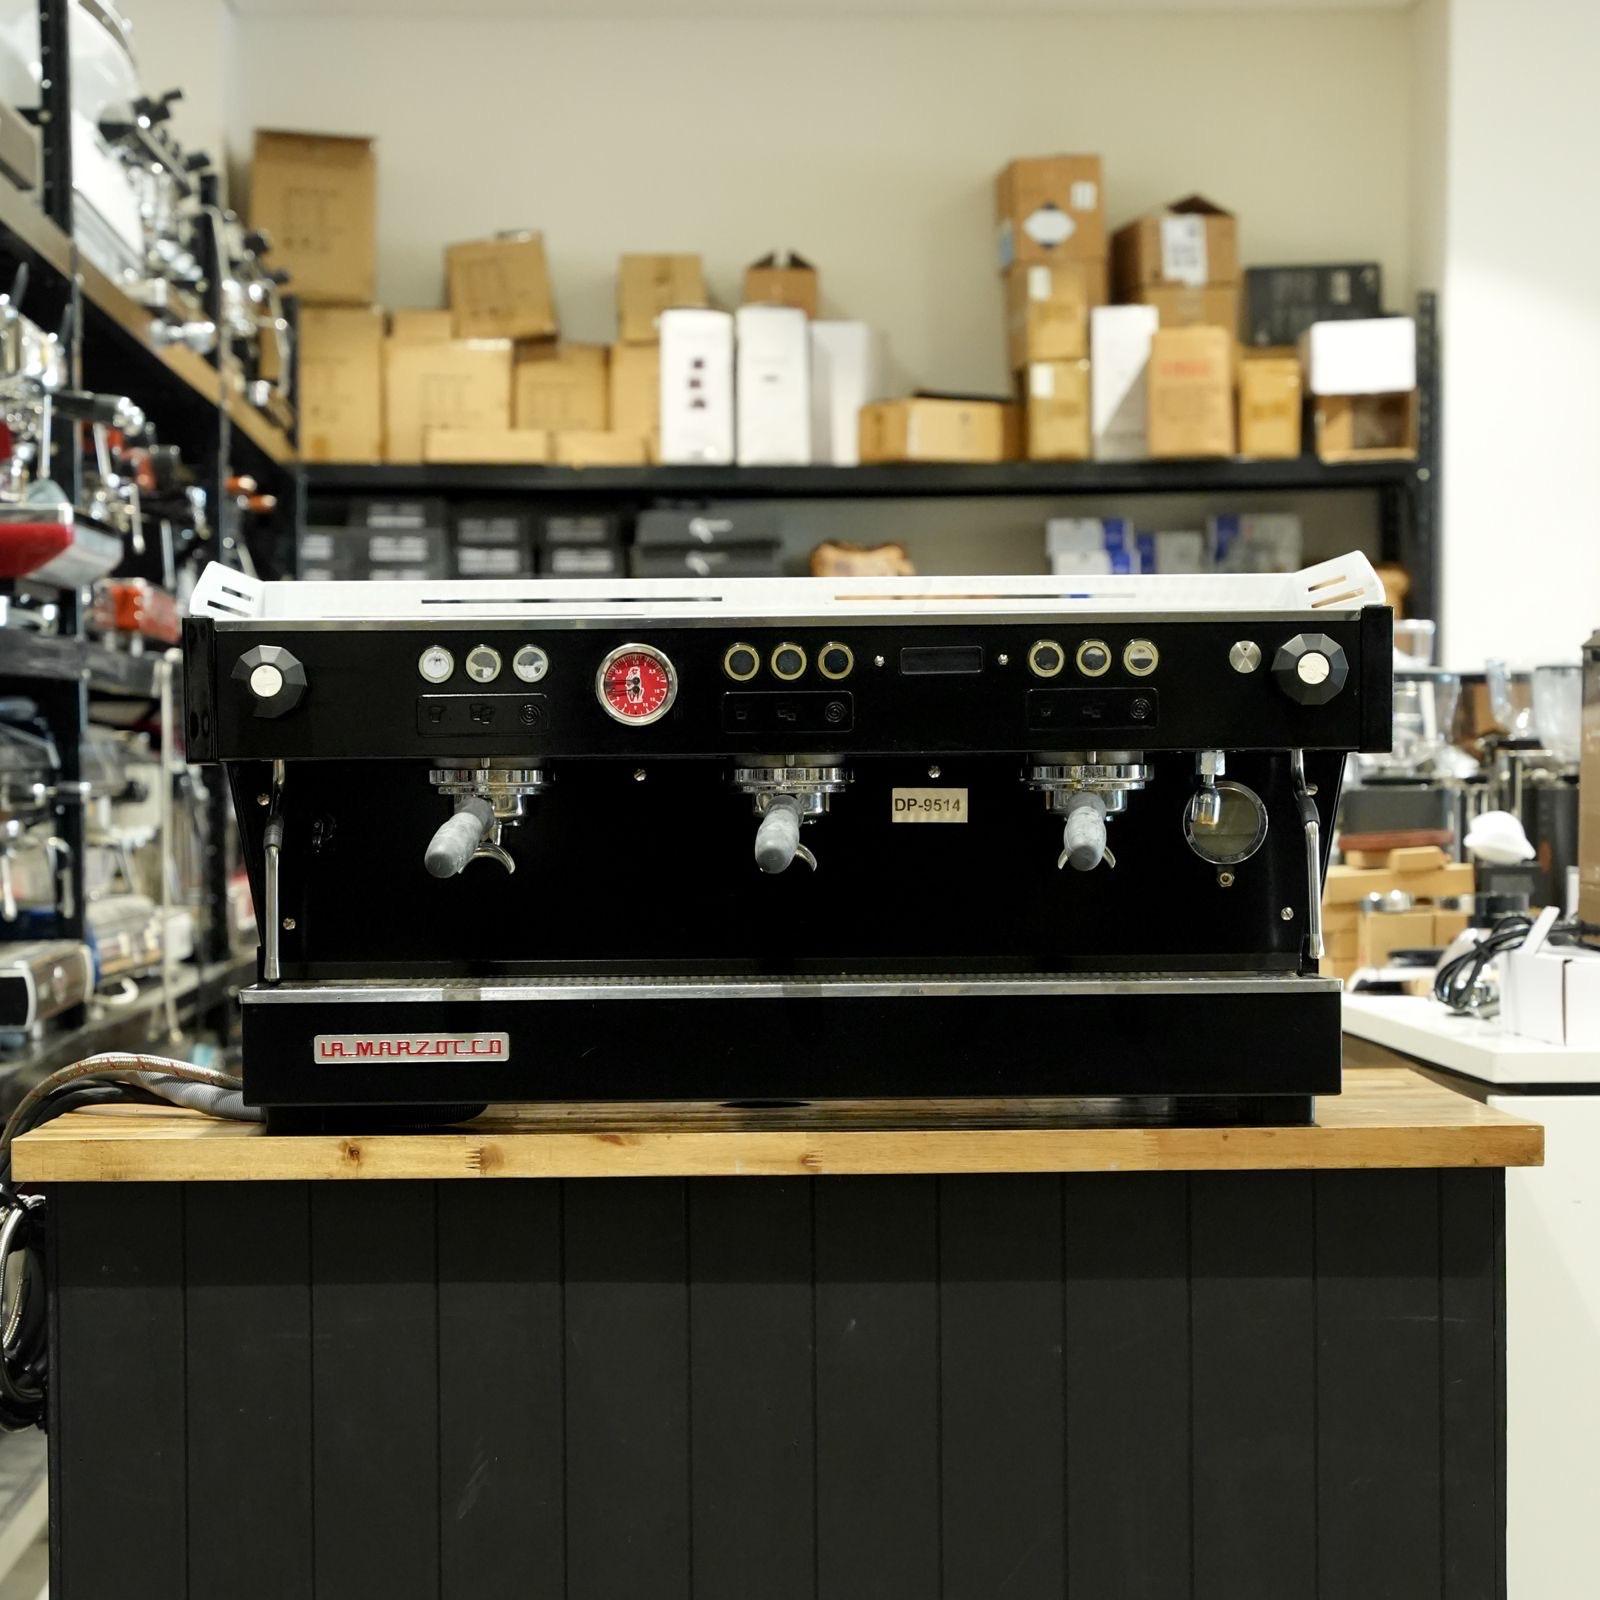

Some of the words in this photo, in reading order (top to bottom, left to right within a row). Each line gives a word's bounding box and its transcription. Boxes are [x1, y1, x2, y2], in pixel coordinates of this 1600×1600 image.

[894, 798, 961, 812] DP-9514
[321, 1042, 343, 1057] LA
[356, 1040, 502, 1056] MARZOCCO
